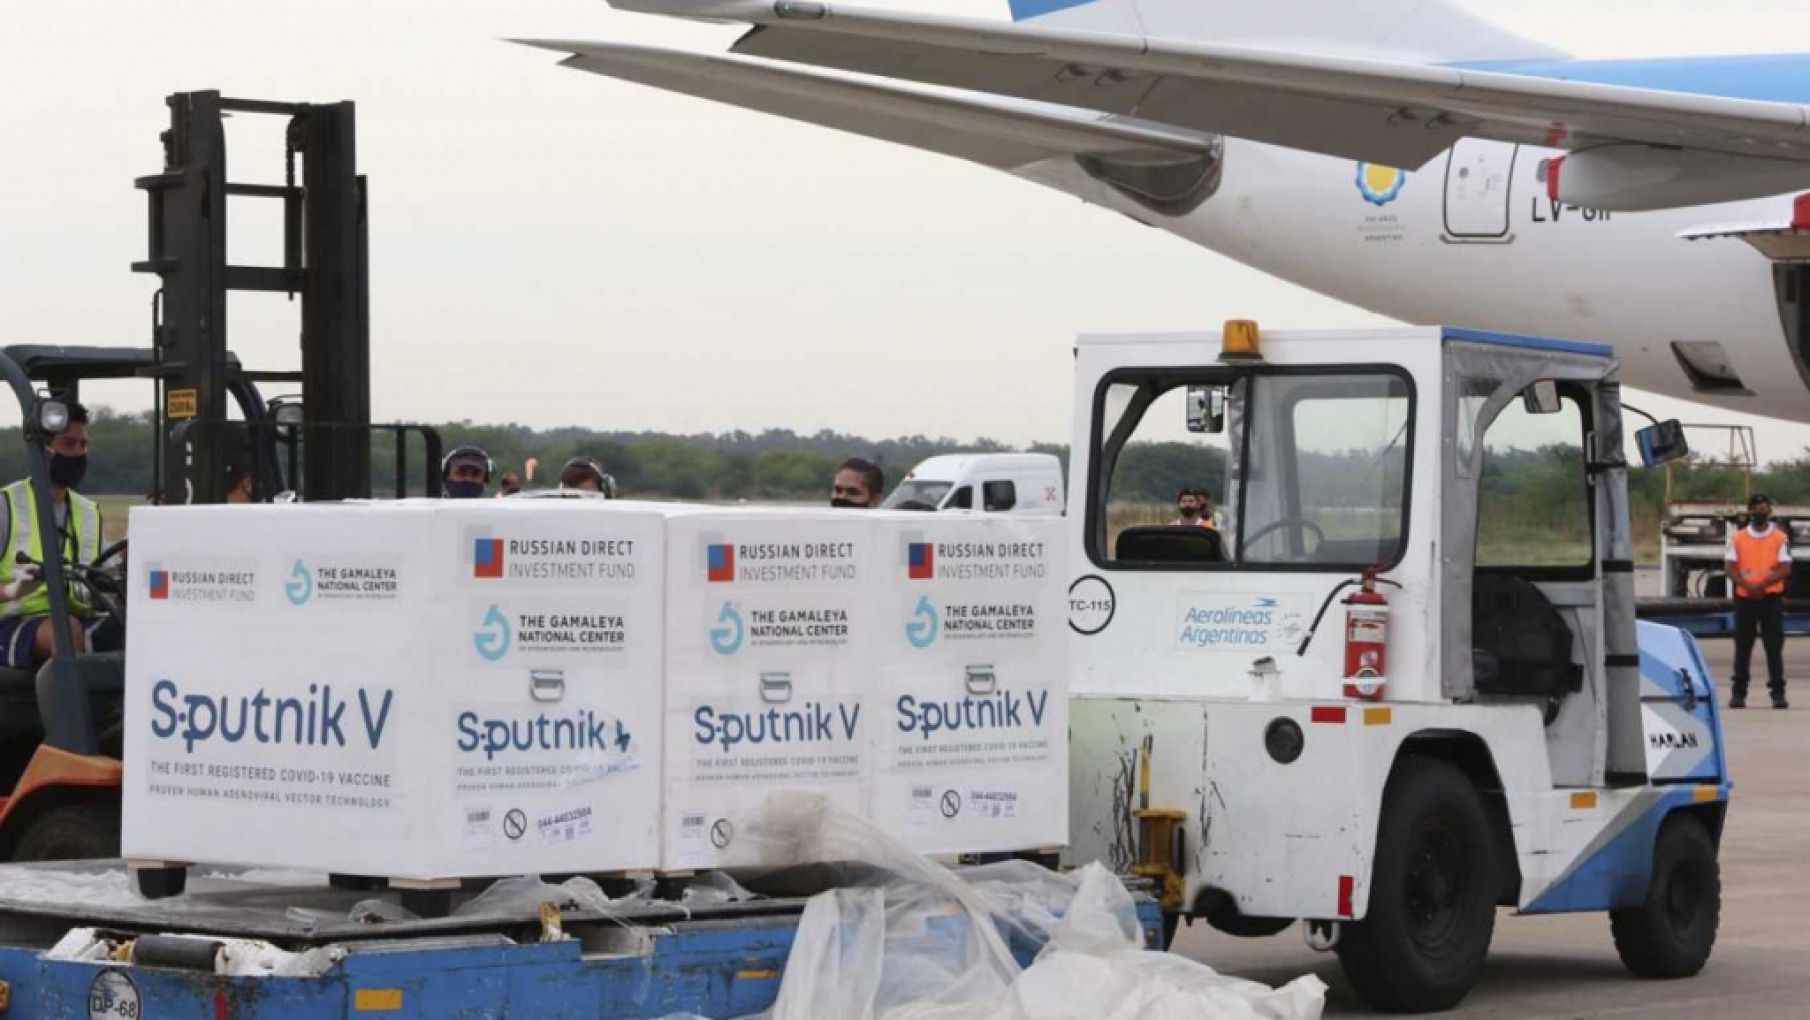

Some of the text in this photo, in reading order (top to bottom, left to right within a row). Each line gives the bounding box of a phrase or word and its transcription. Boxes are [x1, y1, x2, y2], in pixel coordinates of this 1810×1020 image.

[509, 540, 635, 556] RUSSIAN DIRECT
[740, 543, 854, 559] RUSSIAN DIRECT
[938, 543, 1044, 557] RUSSIAN DIRECT
[318, 568, 397, 579] THE GAMALEYA
[509, 563, 636, 578] INVESTMENT FUND
[739, 564, 857, 581] INVESTMENT FUND
[938, 564, 1045, 579] INVESTMENT FUND
[172, 571, 255, 585] RUSSIAN DIRECT
[318, 580, 397, 592] NATIONAL CENTER
[172, 588, 255, 602] INVESTMENT FUND
[946, 604, 1034, 617] THE GAMALEYA
[1069, 600, 1111, 611] TC-115
[519, 615, 625, 629] THE GAMALEYA
[752, 609, 848, 623] THE GAMALEYA
[751, 625, 848, 637] NATIONAL CENTER
[944, 619, 1035, 630] NATIONAL CENTER
[518, 630, 625, 643] NATIONAL CENTER
[1180, 626, 1268, 647] Argentinas
[151, 679, 393, 753] Sputnik V
[897, 690, 1048, 740] Sputnik V
[457, 708, 607, 760] Sputnik
[695, 702, 860, 753] Sputnik V
[151, 761, 391, 788] THE FIRST REGISTERED COVID-19 VACCINE
[149, 784, 390, 809] PROVEN HUMAN ADENOVIRAL VECTOR TECHNOLOGY
